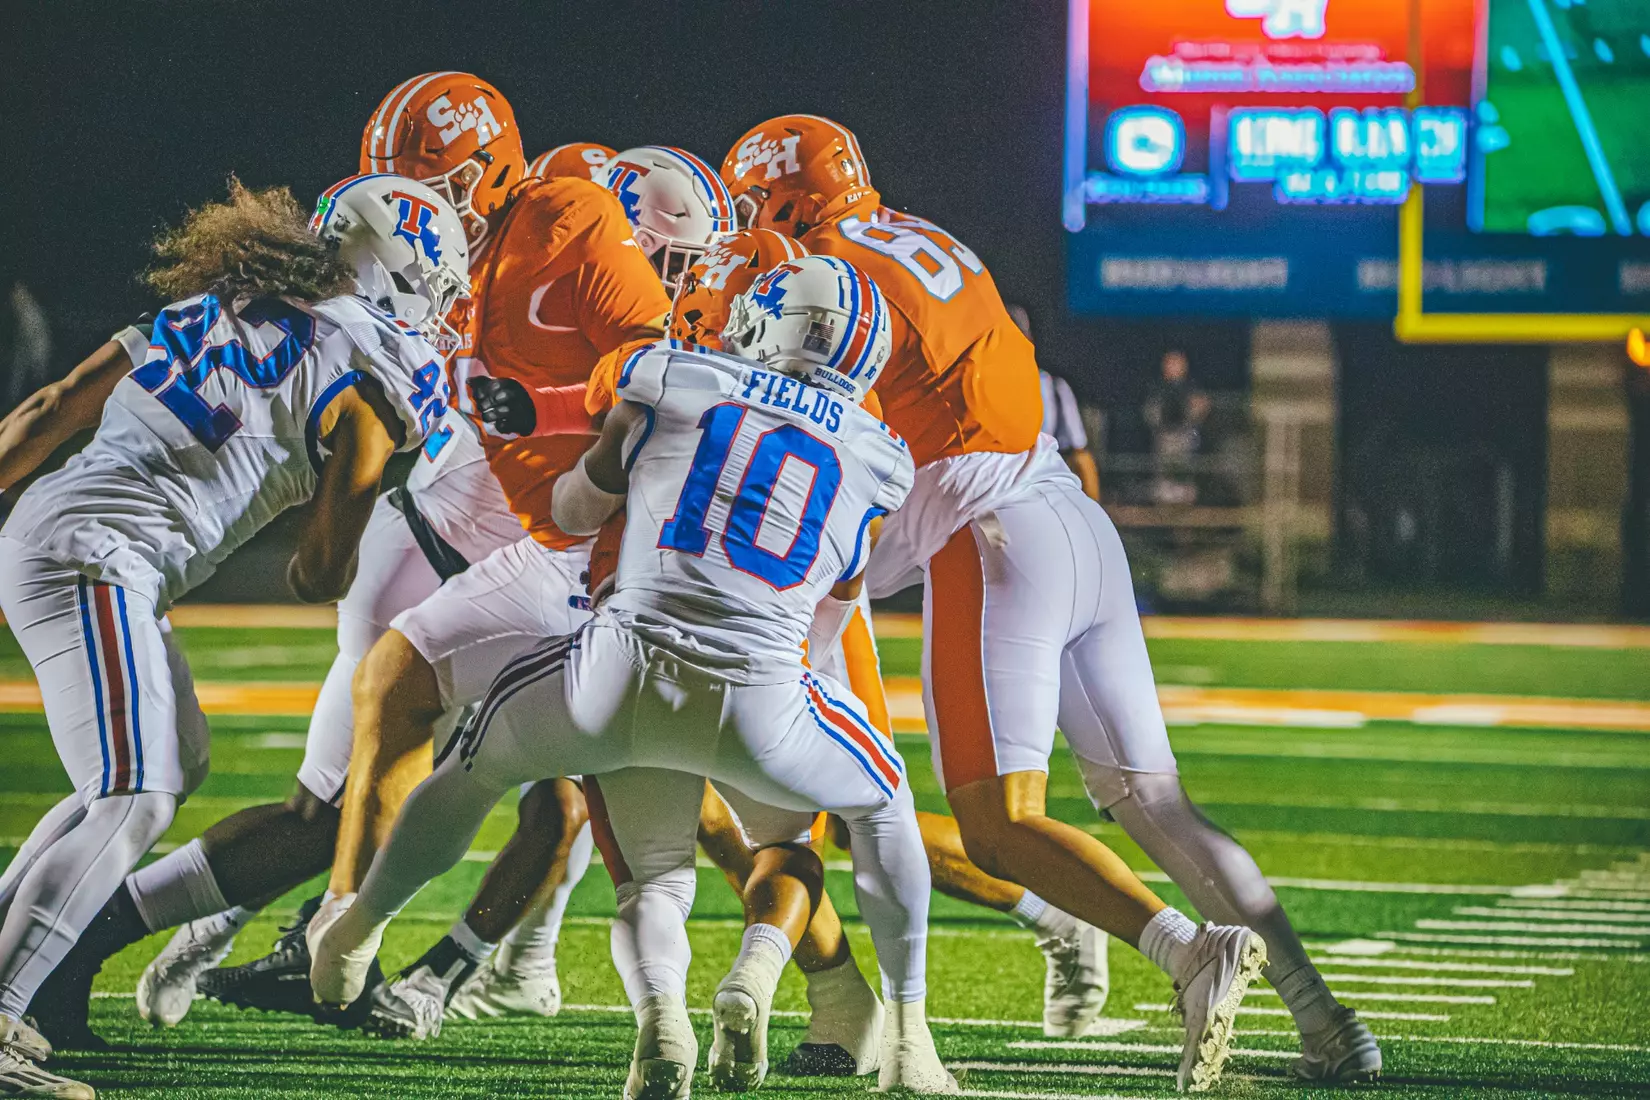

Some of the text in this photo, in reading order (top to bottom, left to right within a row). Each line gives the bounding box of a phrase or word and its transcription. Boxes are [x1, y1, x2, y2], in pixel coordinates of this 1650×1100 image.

[742, 369, 844, 433] FIELDS
[814, 367, 856, 394] BULLDOGS
[657, 401, 843, 591] 10
